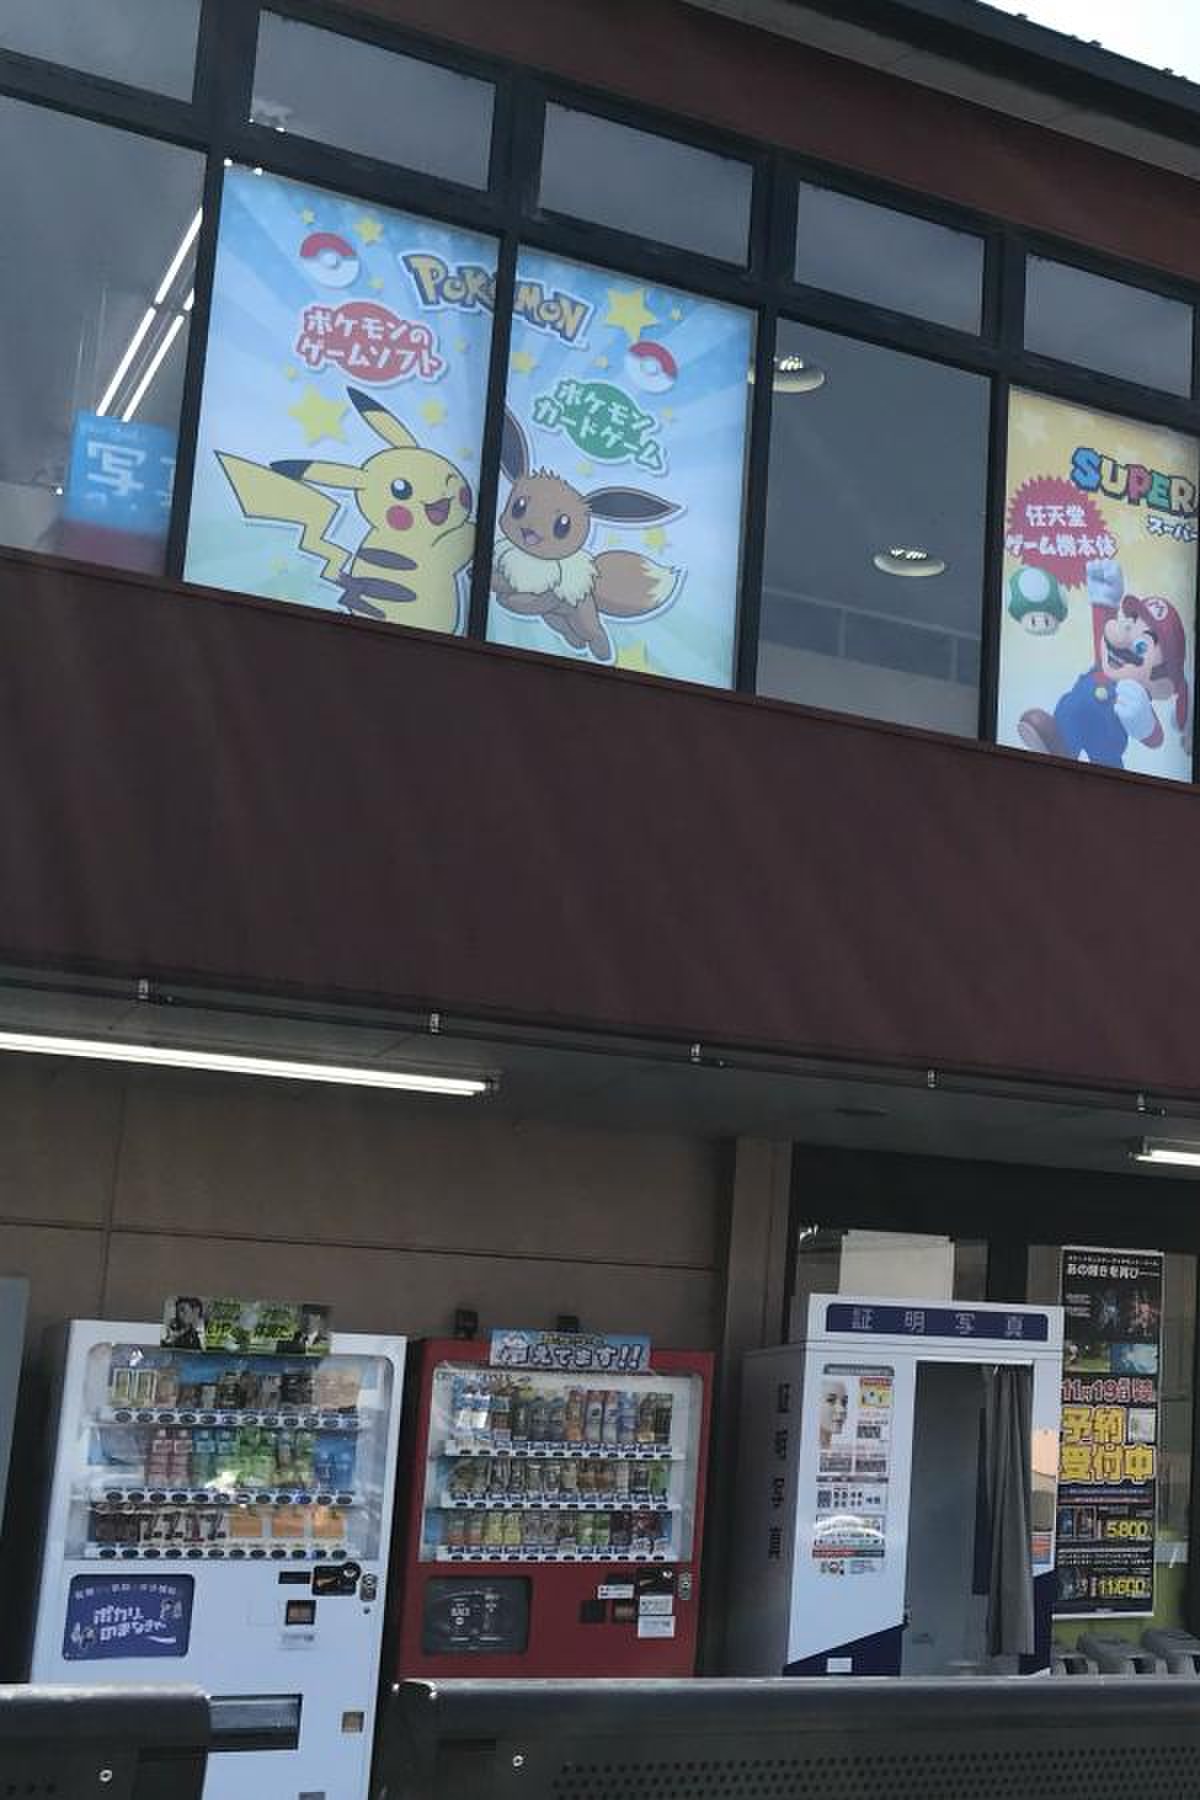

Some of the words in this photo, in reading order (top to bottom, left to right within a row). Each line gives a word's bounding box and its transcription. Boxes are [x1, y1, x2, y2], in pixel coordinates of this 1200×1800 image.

[306, 310, 431, 347] ポケモンの
[300, 338, 442, 376] ゲームソフト
[557, 380, 653, 431] ポケモン
[535, 397, 661, 467] カードゲーム
[1070, 447, 1198, 517] SUPER
[1026, 504, 1088, 528] 任天堂
[1006, 533, 1117, 558] ゲーム機本体
[851, 1308, 1025, 1339] 証明写真
